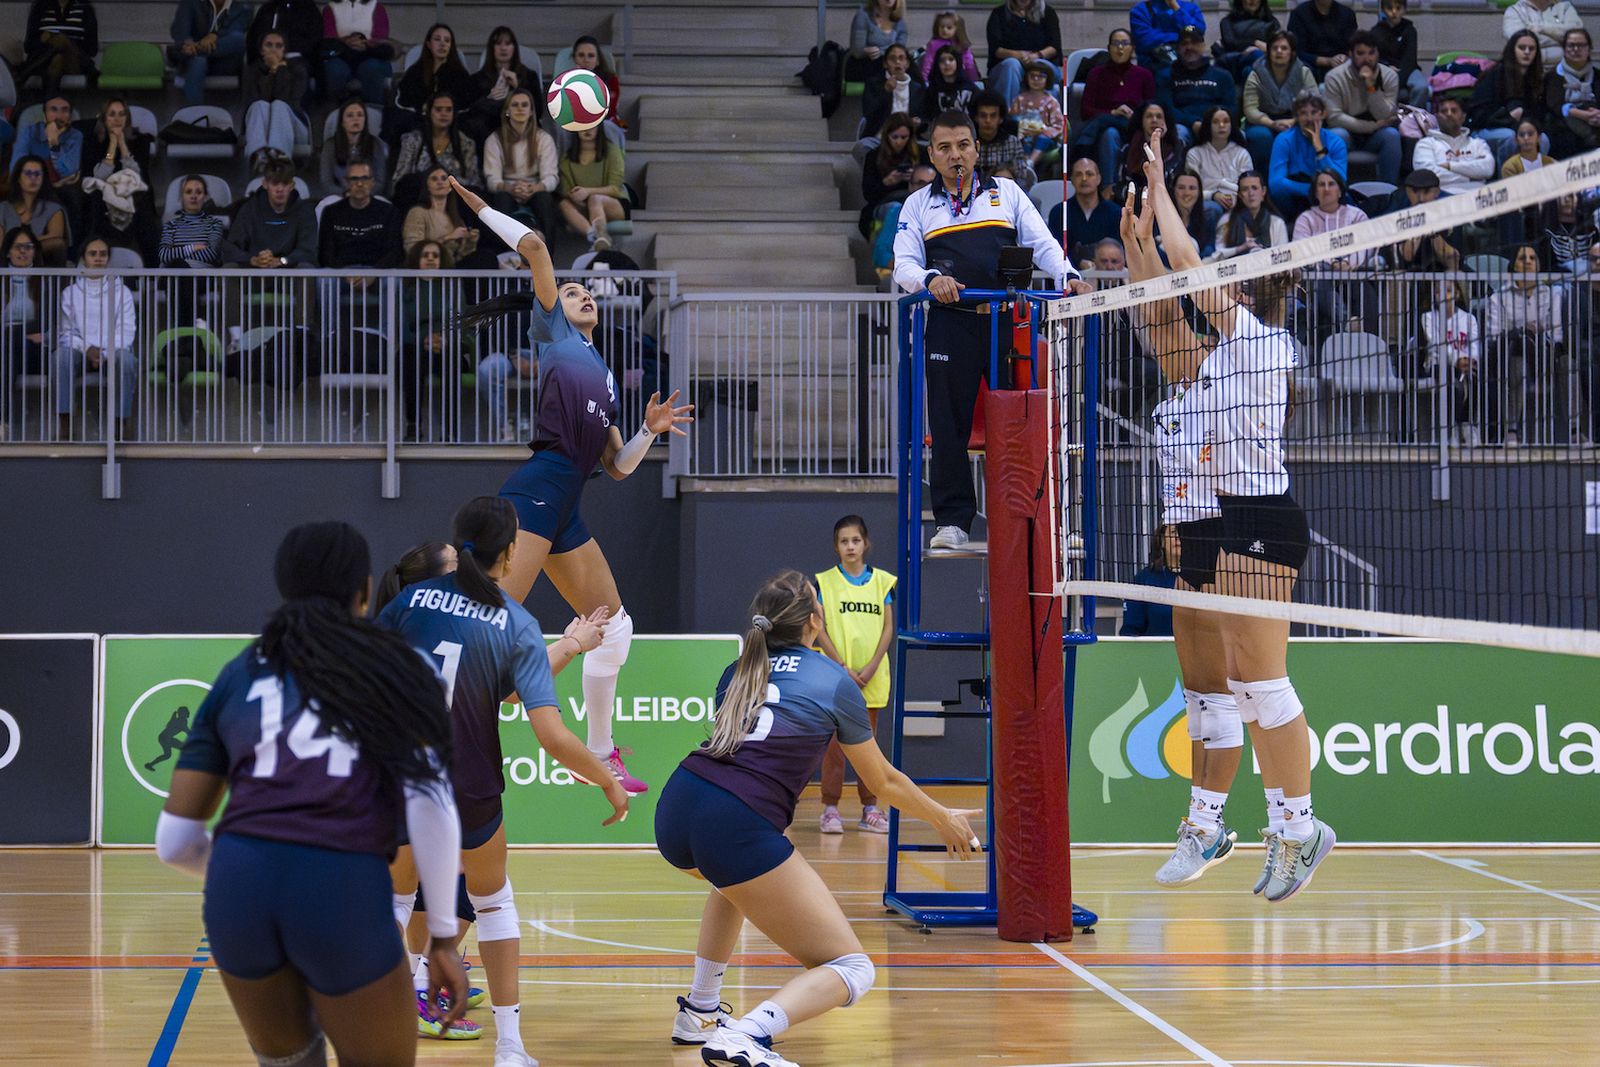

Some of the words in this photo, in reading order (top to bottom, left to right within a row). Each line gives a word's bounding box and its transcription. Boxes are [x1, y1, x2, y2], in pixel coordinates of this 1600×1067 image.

[409, 588, 509, 631] FIGUEROA
[245, 675, 360, 778] 14
[568, 696, 716, 722] VLEIBOL
[1252, 704, 1600, 776] erdrola
